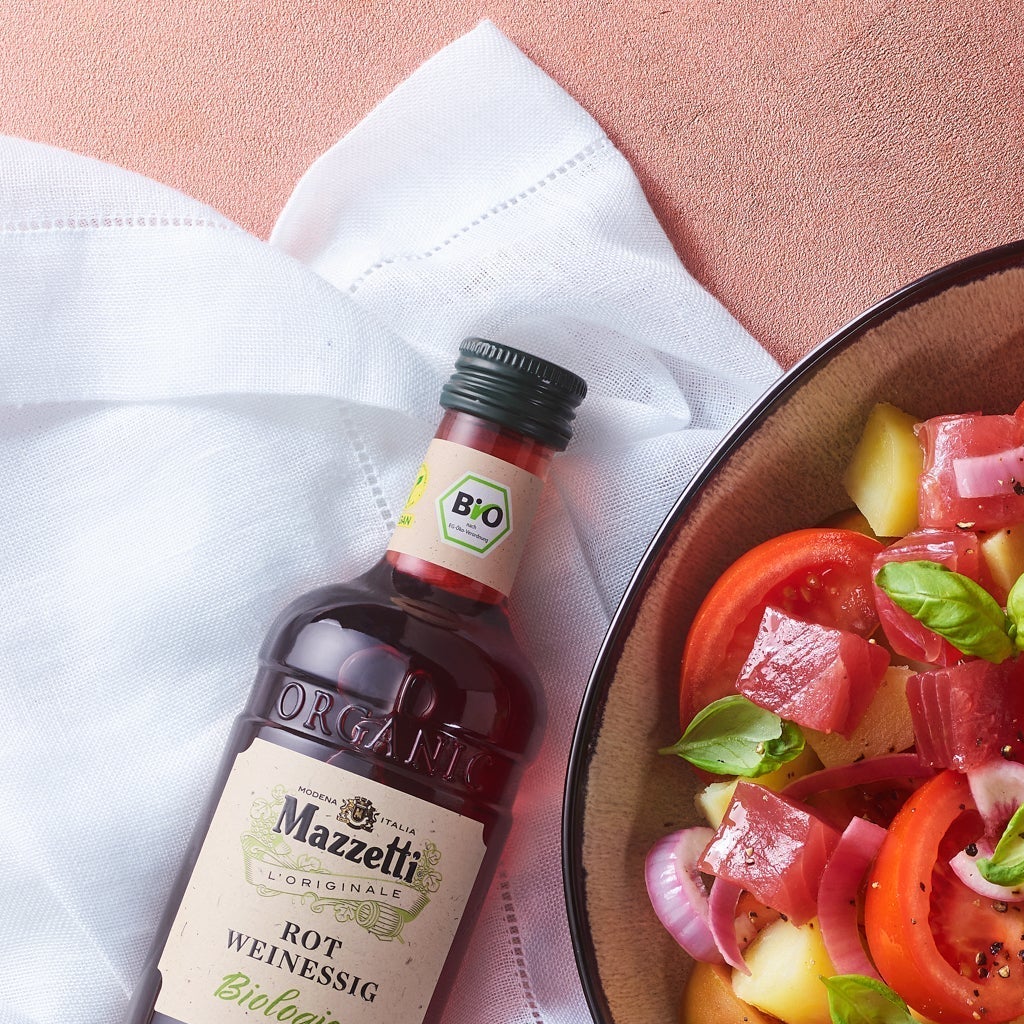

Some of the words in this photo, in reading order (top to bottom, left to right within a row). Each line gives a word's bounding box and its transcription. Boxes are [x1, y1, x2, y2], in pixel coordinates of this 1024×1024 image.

[277, 681, 494, 791] ORGANIC
[272, 794, 421, 884] Mazzetti
[298, 786, 337, 805] MODENA
[380, 817, 416, 836] ITALIA
[268, 871, 402, 899] L'ORIGINALE
[226, 928, 379, 1003] WEINESSIG
[279, 920, 343, 960] ROT
